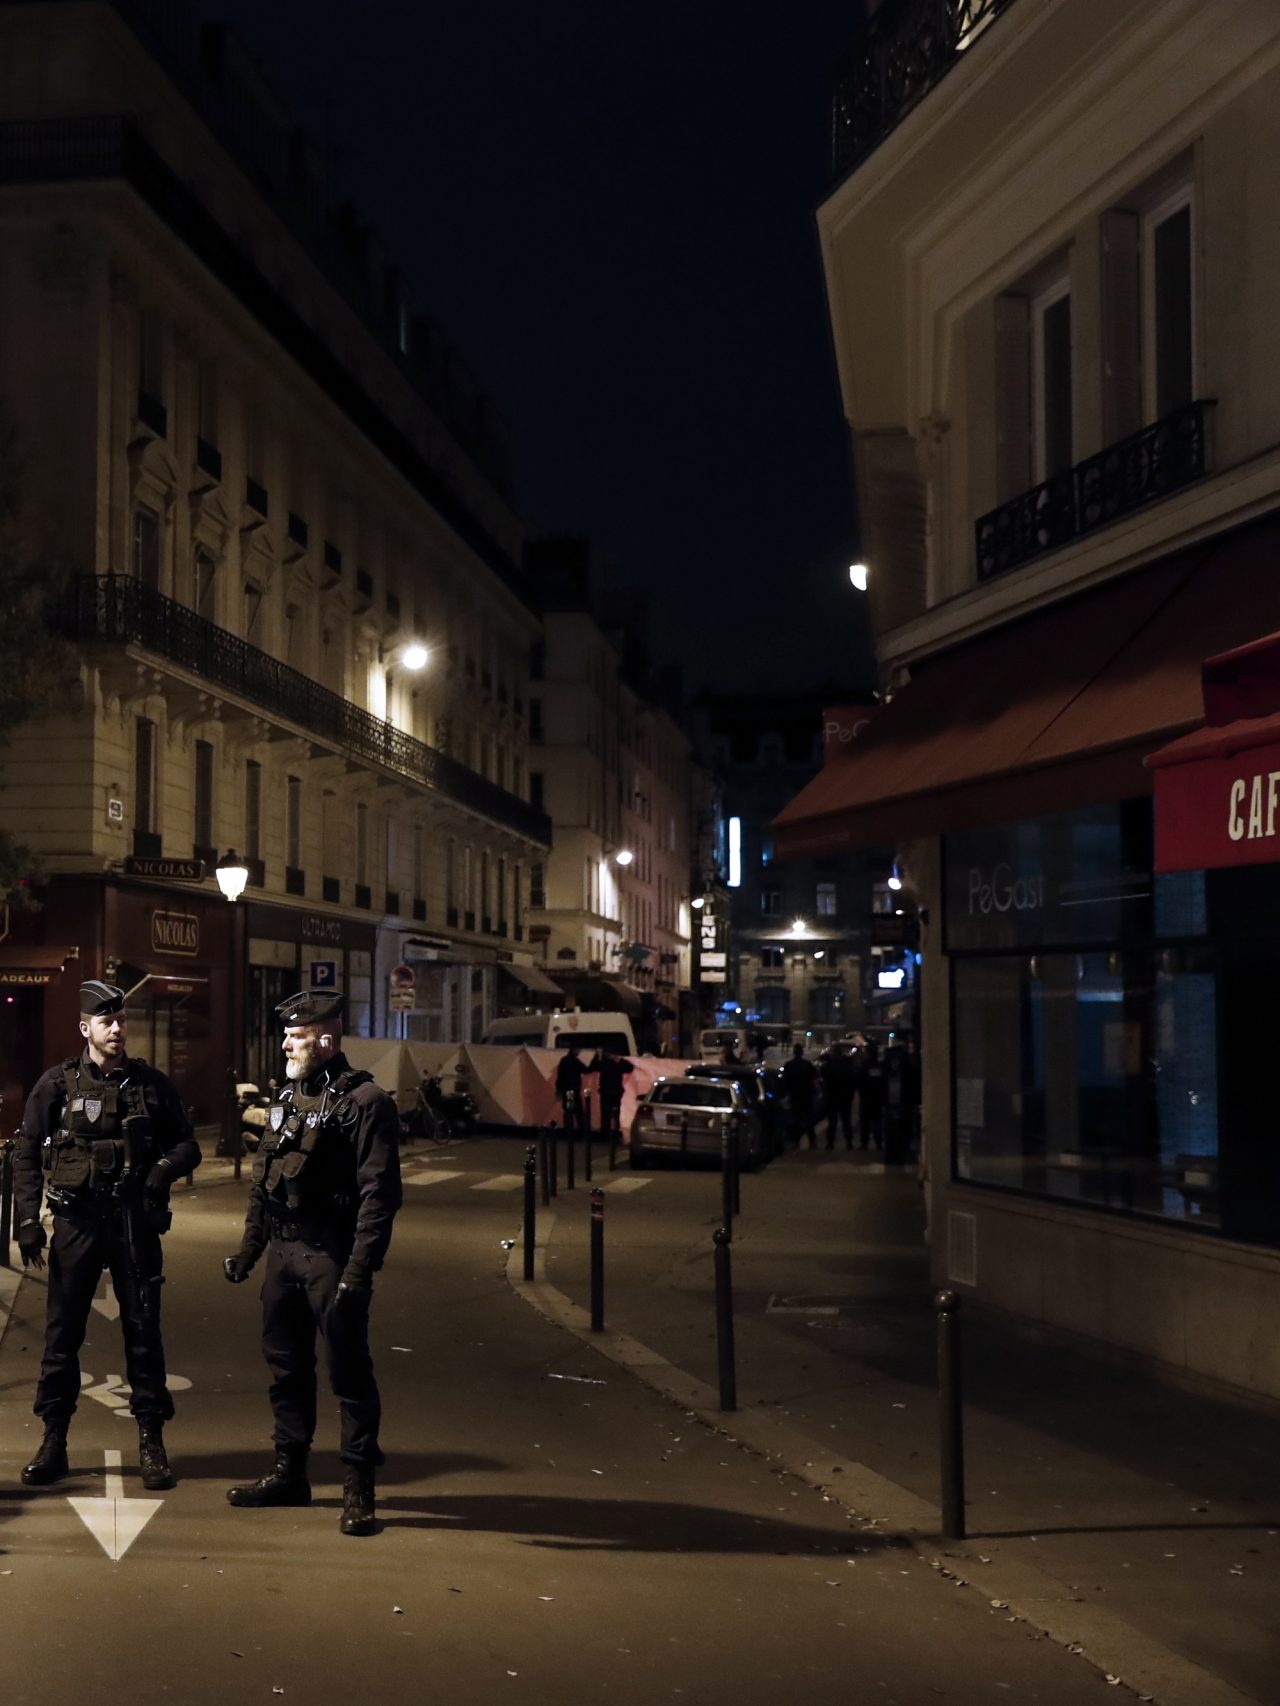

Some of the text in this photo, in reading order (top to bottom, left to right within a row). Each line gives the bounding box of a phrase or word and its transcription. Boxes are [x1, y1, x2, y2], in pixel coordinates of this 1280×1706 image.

[133, 861, 195, 877] NICOLAS
[969, 862, 1044, 916] PeGast
[155, 919, 197, 948] NICOLAS
[316, 966, 329, 984] P
